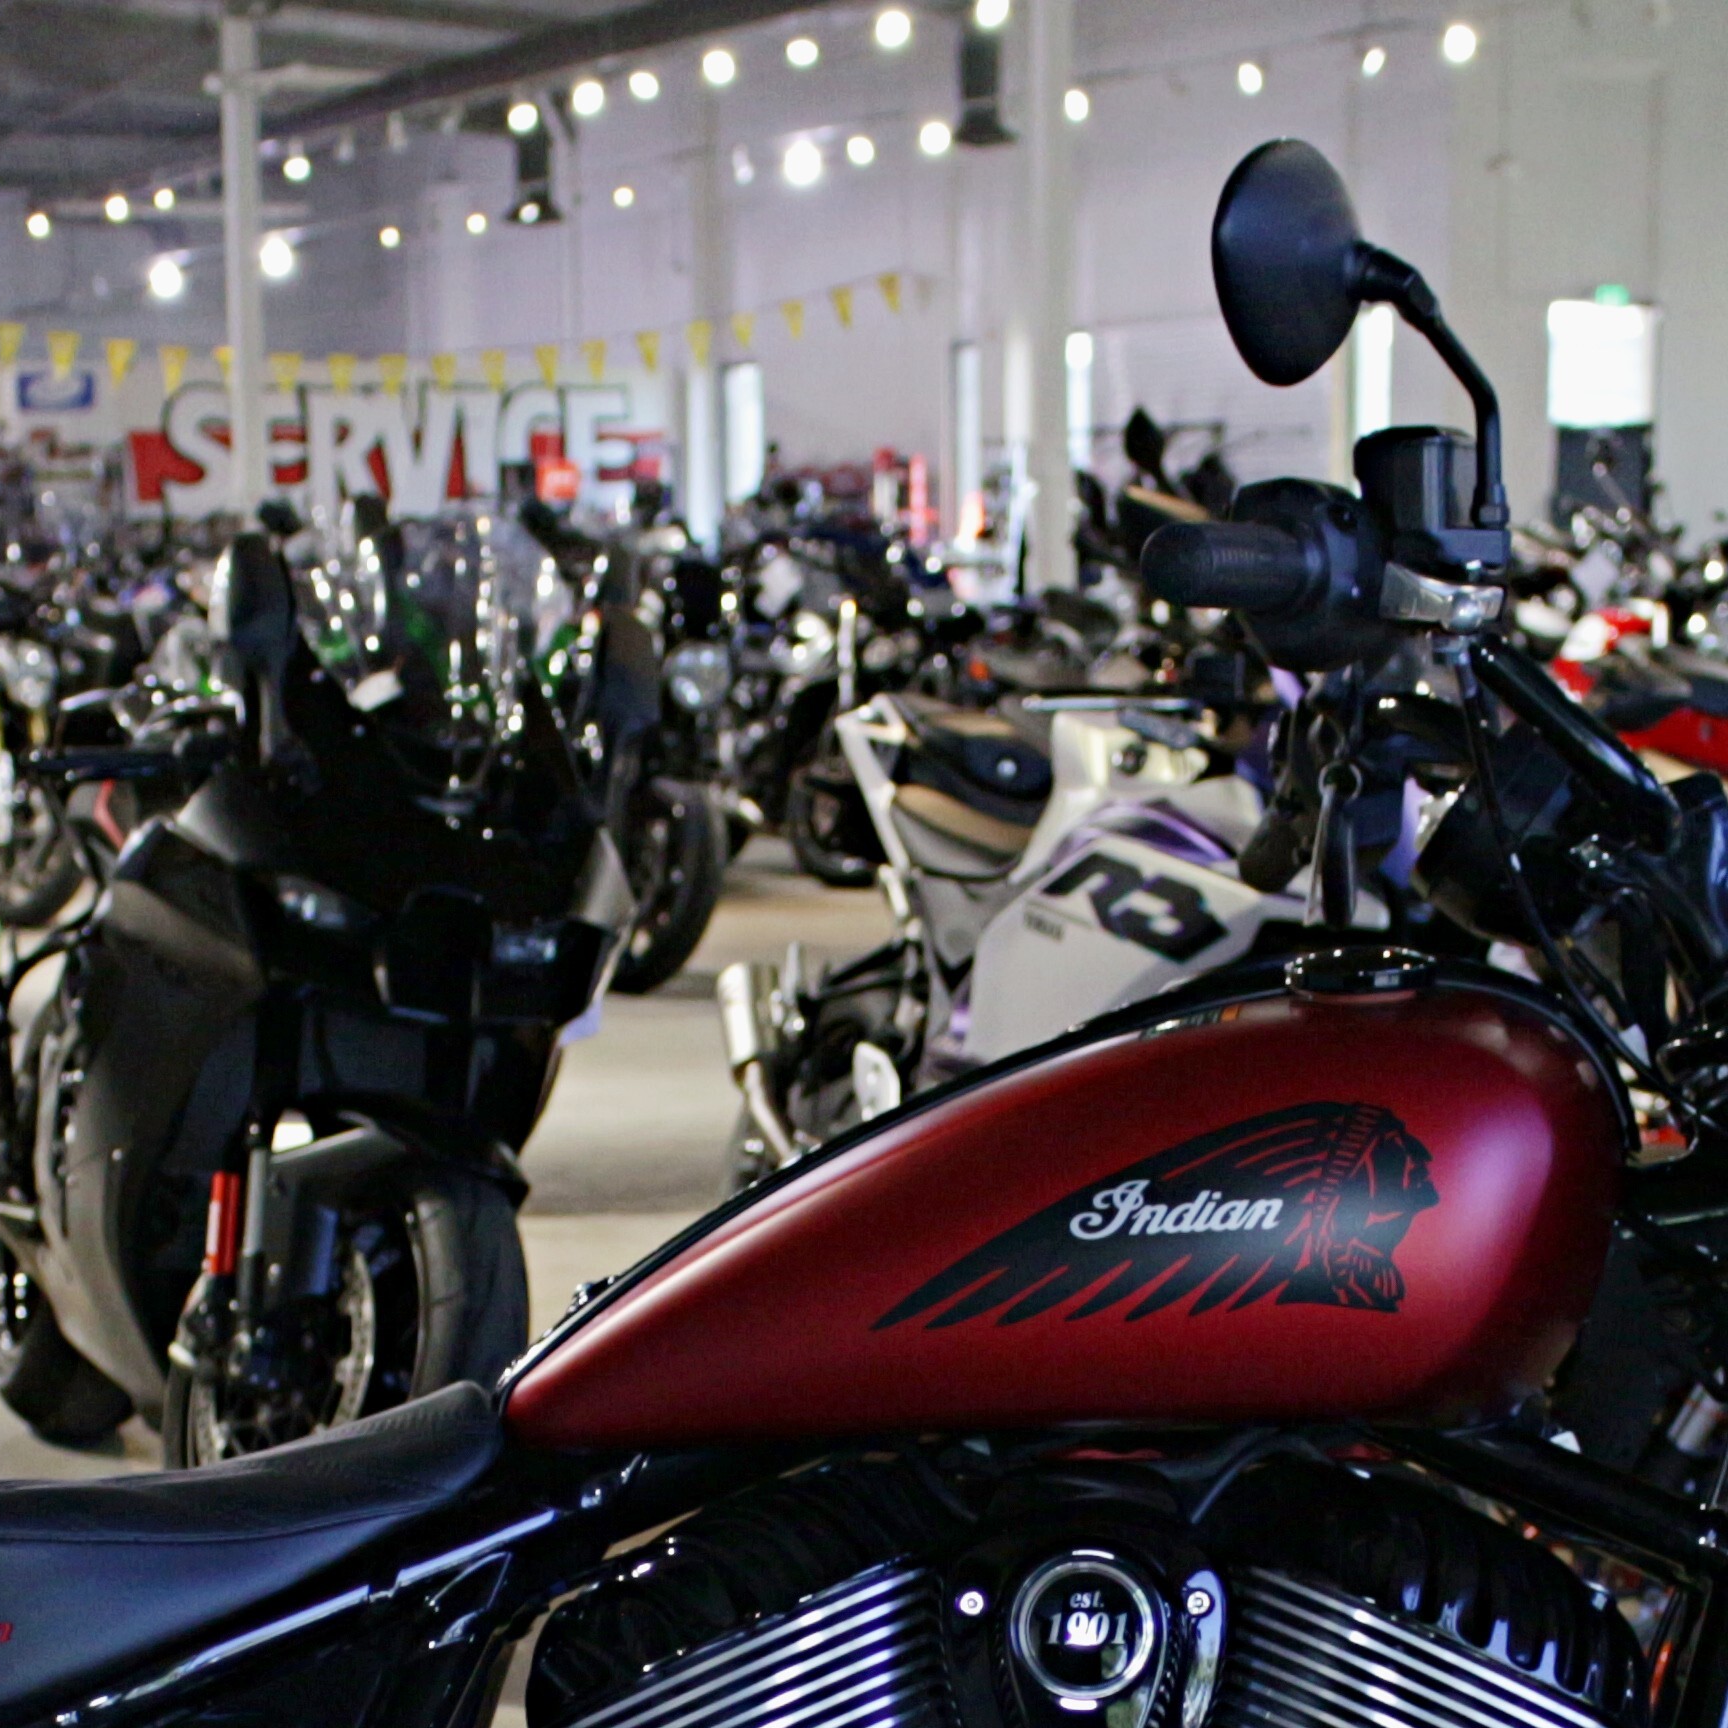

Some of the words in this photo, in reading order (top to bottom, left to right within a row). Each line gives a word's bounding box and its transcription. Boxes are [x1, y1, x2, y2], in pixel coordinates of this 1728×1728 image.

[161, 380, 638, 520] SERVICE
[1068, 1178, 1284, 1241] Indian
[1069, 1590, 1105, 1609] est.
[1047, 1611, 1129, 1646] 1901
